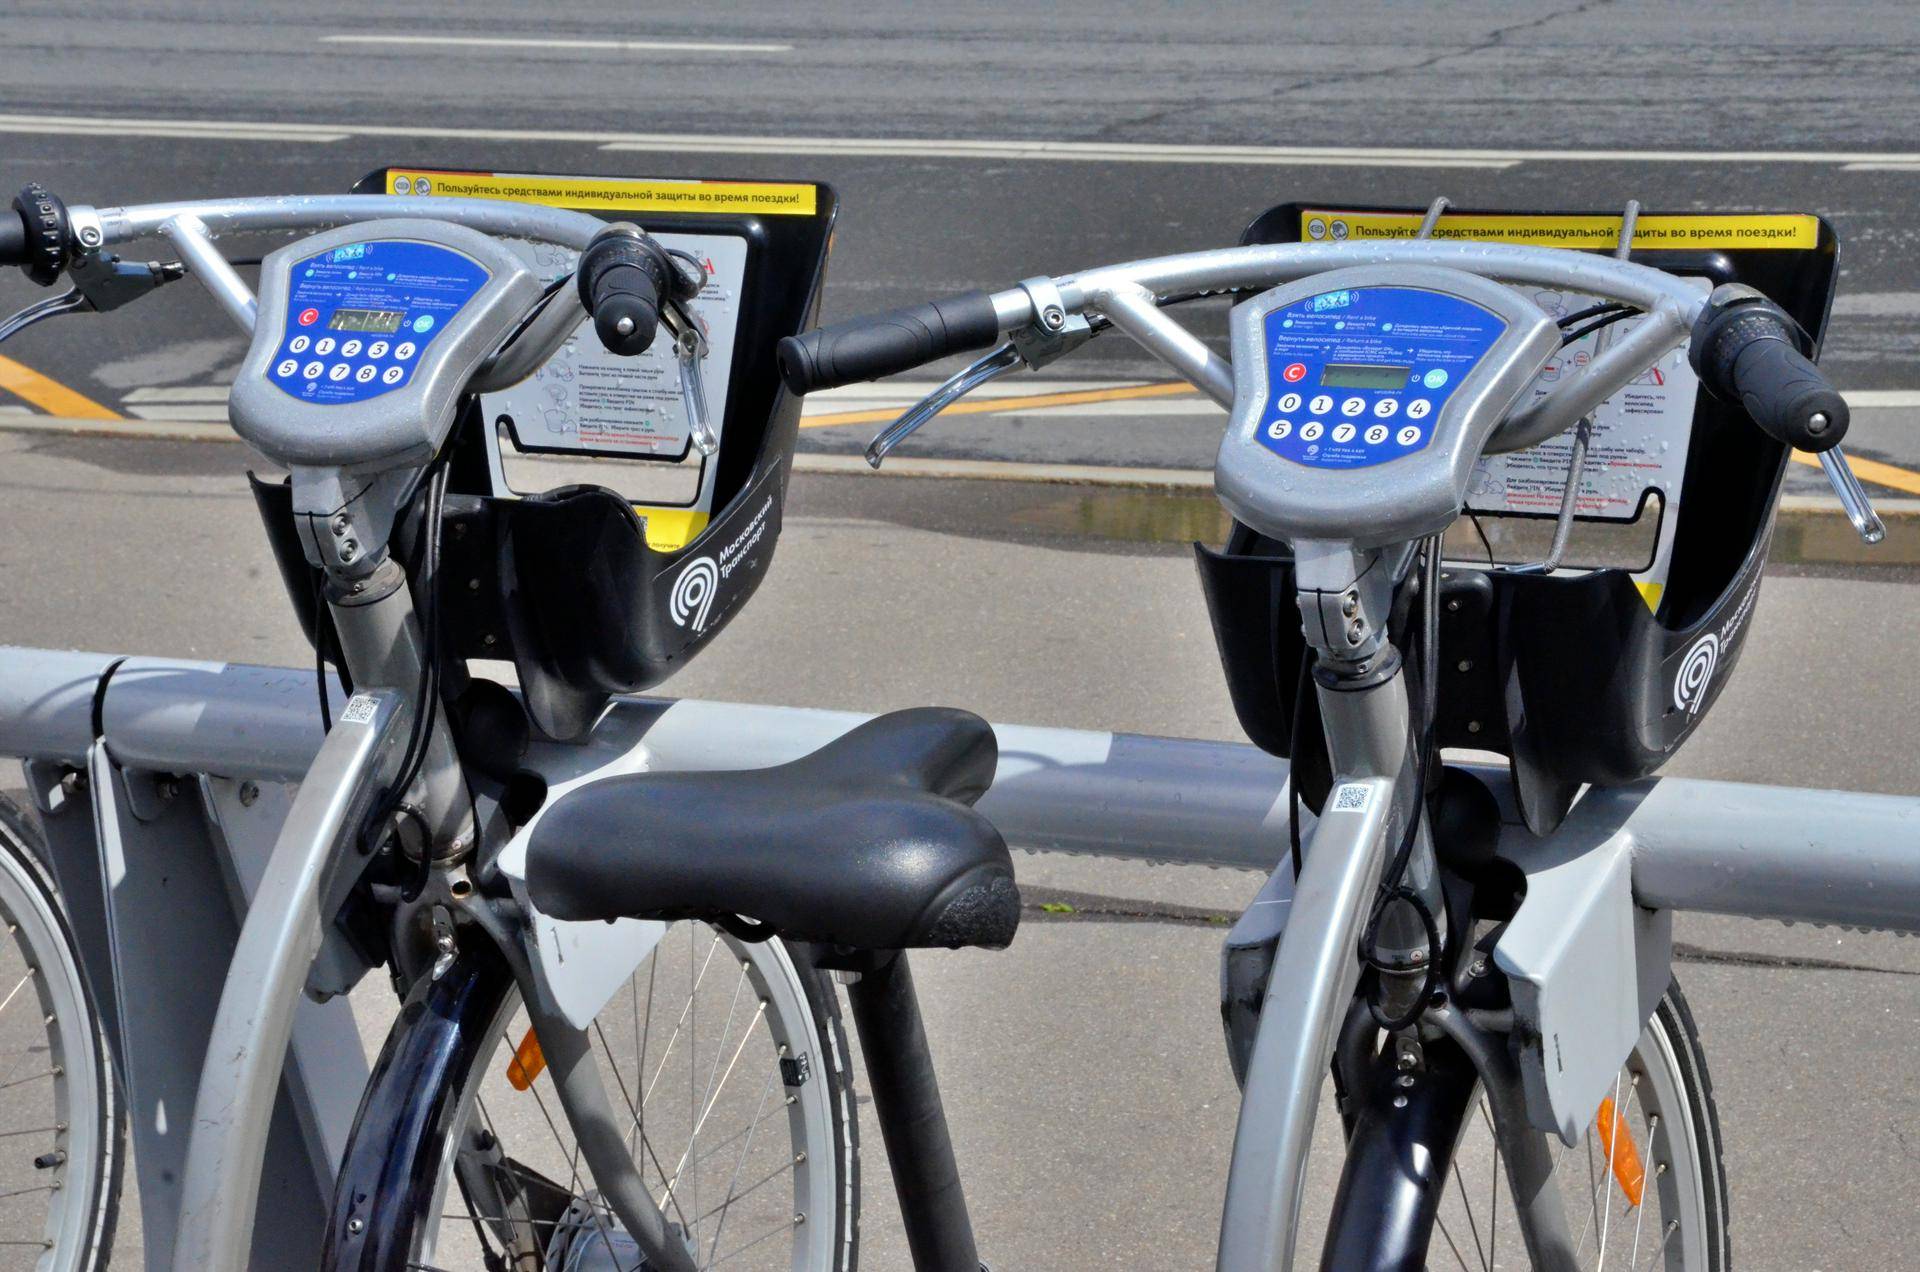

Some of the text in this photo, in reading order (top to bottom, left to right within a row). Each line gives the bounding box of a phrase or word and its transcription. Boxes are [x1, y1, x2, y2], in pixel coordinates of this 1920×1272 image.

[437, 183, 500, 195] Пользуйтесь
[503, 187, 562, 197] средствами
[565, 189, 653, 200] индивидуальной
[655, 192, 696, 202] защиты
[715, 194, 749, 203] время
[752, 194, 799, 203] поездки!
[1356, 226, 1797, 239] Пользуйте средствами индивидуальной щиты во время поездки!
[295, 339, 408, 356] 0 1 2 3 4
[282, 363, 399, 380] 5 6 7 8 9
[1284, 397, 1423, 414] 0 1 2 3 4
[1274, 424, 1414, 441] 5 6 7 8 9
[720, 494, 772, 564] Московский
[720, 521, 765, 578] Транспорт
